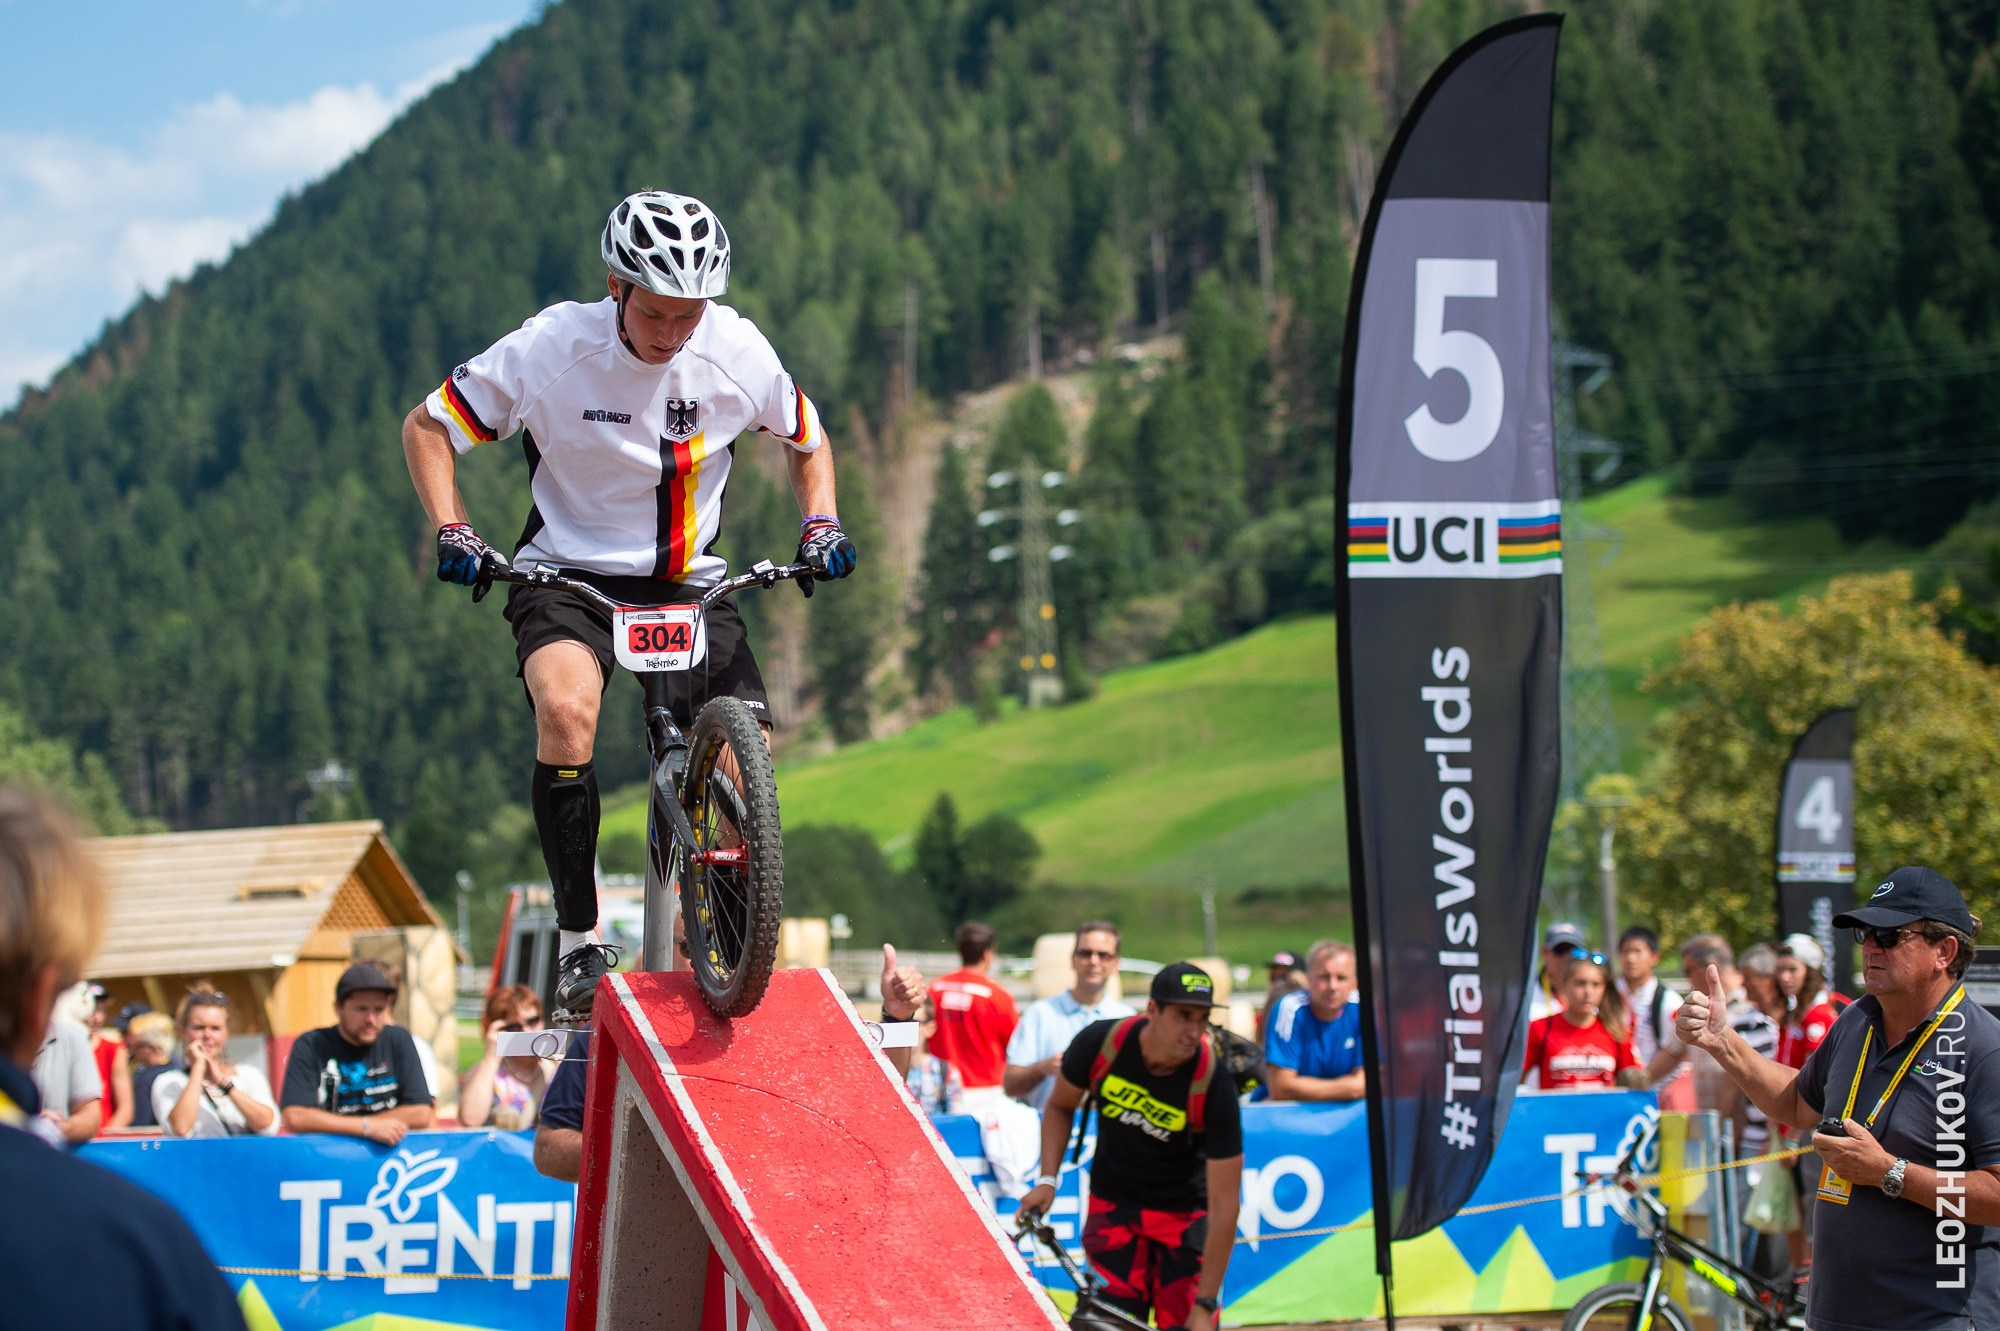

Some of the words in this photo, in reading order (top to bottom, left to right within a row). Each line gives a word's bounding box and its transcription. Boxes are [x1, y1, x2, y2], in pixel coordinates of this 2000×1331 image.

[1404, 258, 1504, 462] 5
[606, 411, 631, 425] RACER
[1392, 516, 1484, 563] UCI
[633, 625, 688, 652] 304
[644, 659, 679, 669] TRENTINO
[1795, 775, 1843, 845] 4
[1421, 645, 1483, 1150] #TrialsWorlds
